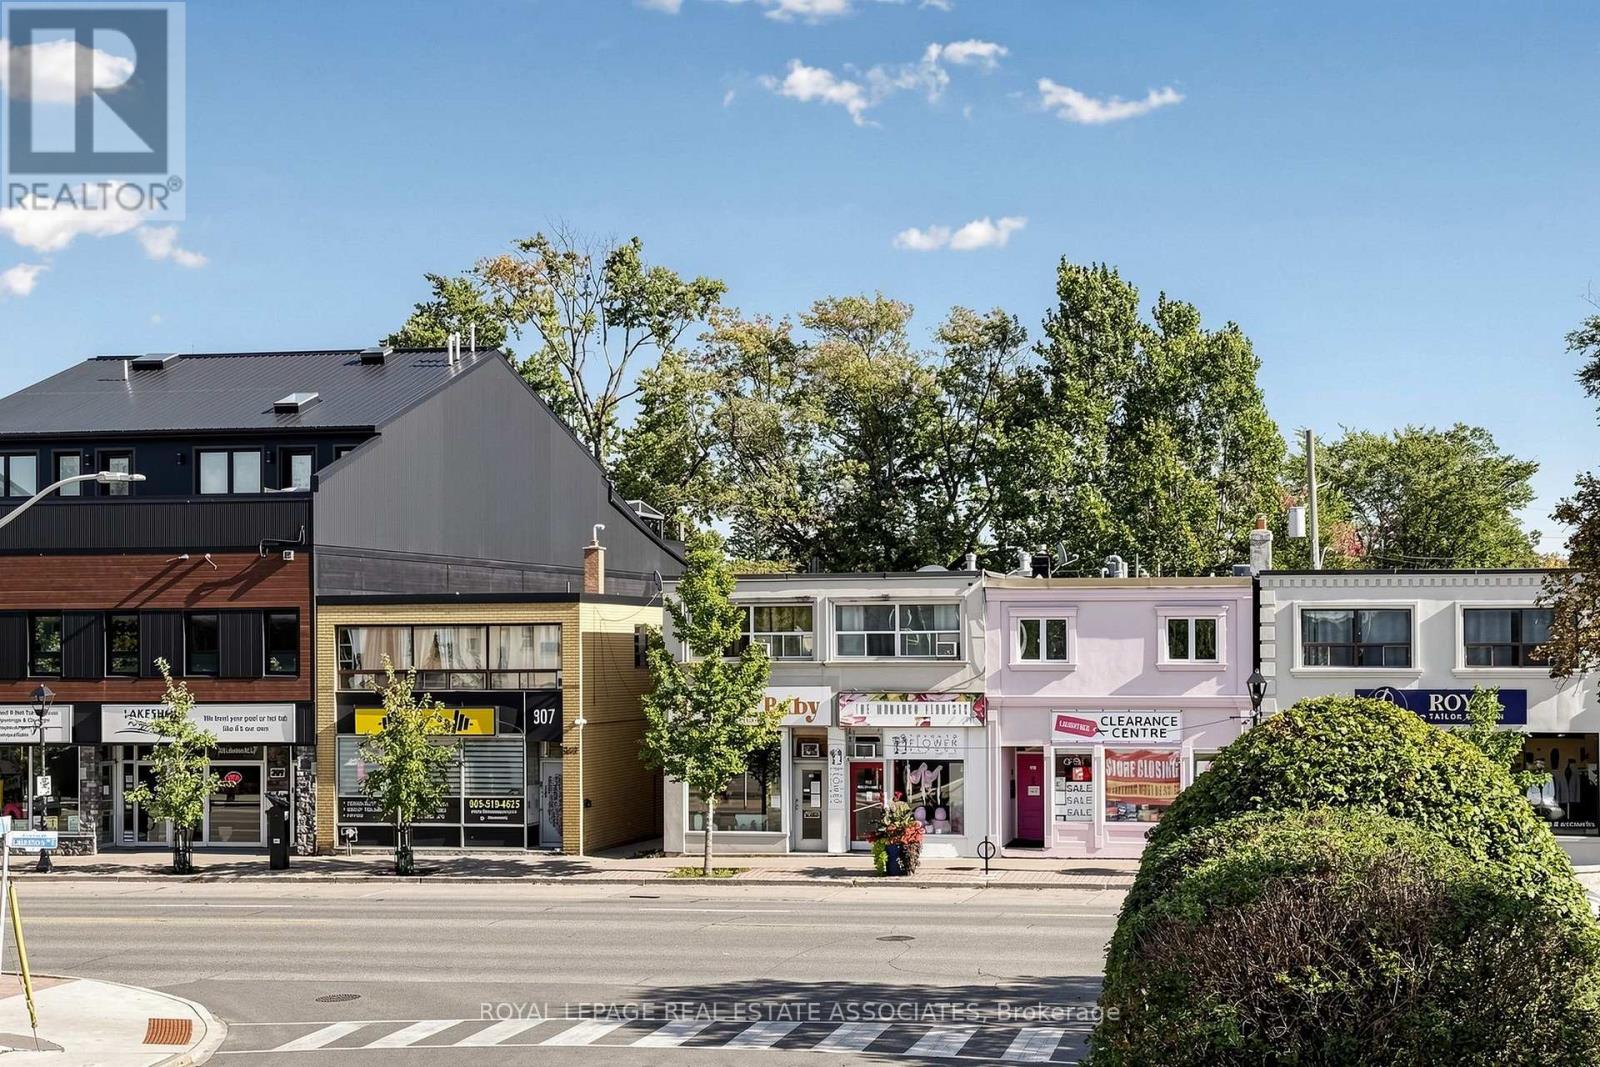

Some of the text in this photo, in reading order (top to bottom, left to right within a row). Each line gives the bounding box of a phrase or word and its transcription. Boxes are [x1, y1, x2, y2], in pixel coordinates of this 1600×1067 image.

[533, 708, 556, 724] 307
[1100, 716, 1178, 726] CLEARANCE
[1112, 728, 1167, 738] CENTRE
[1106, 758, 1136, 777] STORE
[1138, 759, 1179, 779] CLOSING
[1066, 784, 1092, 792] SALE
[1066, 796, 1092, 804] SALE
[1066, 808, 1092, 816] SALE
